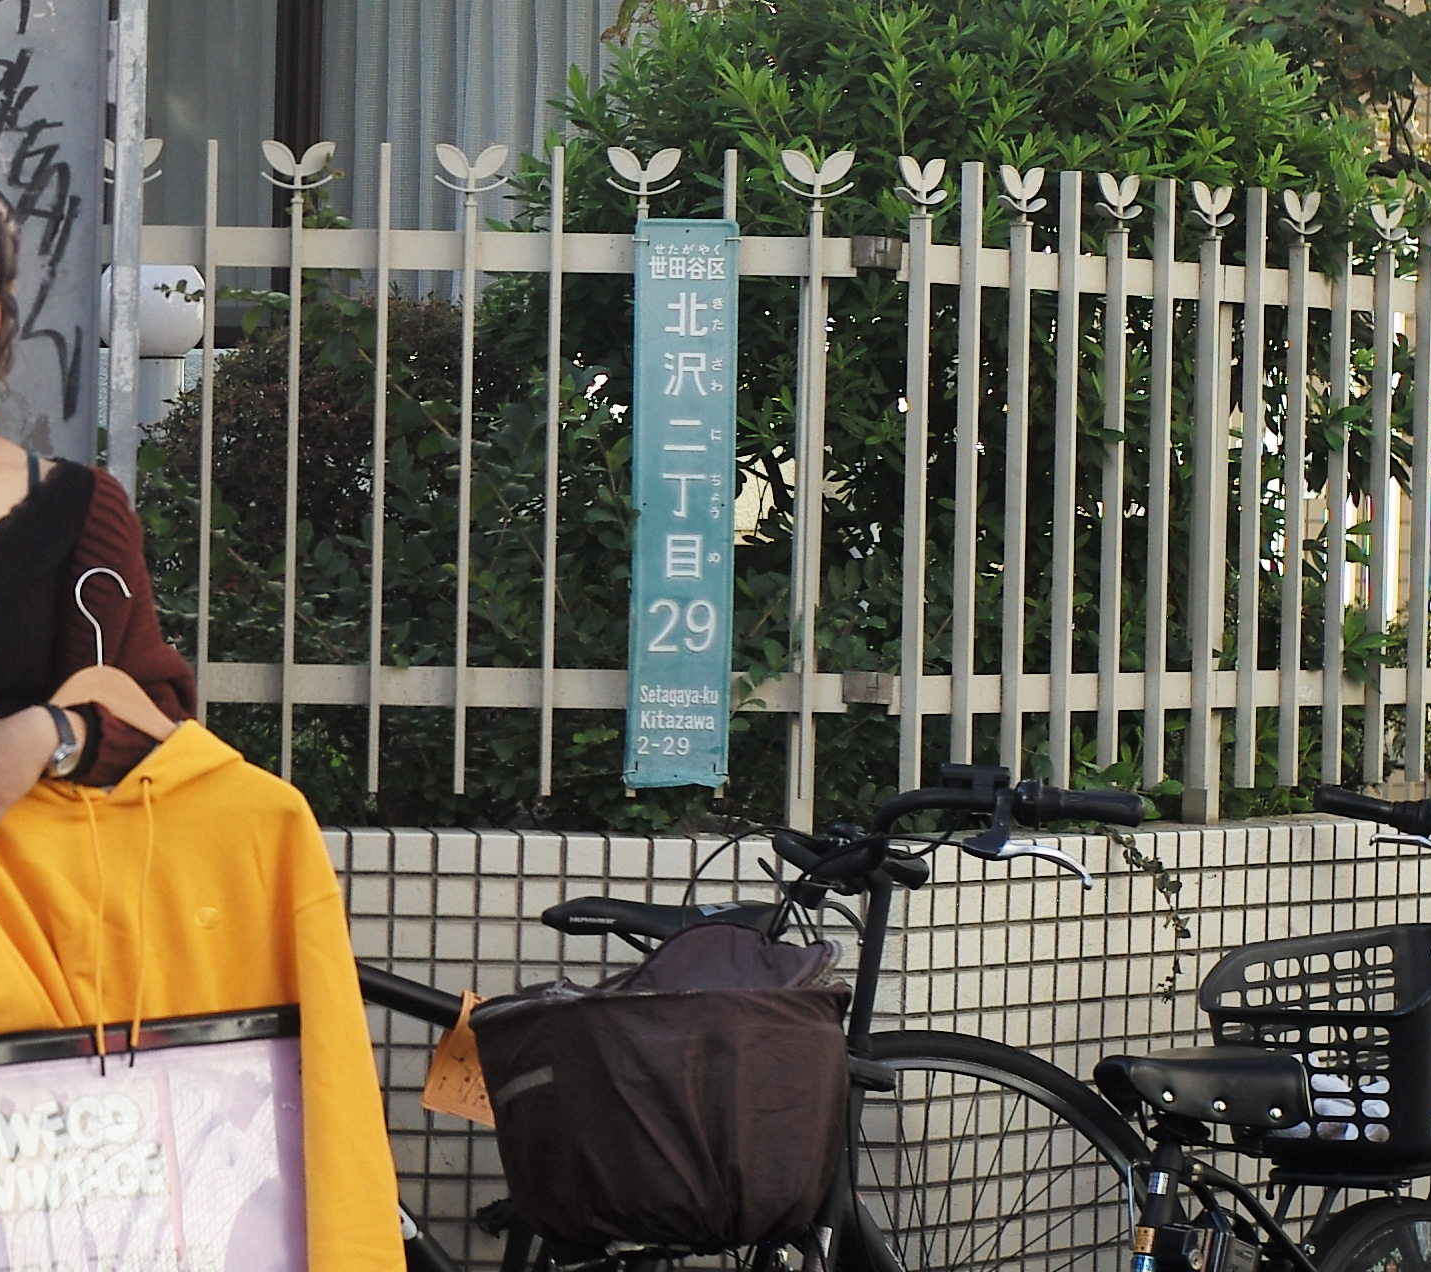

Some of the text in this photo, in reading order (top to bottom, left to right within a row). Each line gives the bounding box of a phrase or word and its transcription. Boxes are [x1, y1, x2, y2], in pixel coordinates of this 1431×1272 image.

[654, 244, 722, 256] せたがやく
[649, 255, 726, 280] 世田谷区
[660, 291, 709, 581] 北沢二丁目
[648, 598, 717, 653] 29
[639, 684, 719, 708] Setagaya-ku
[639, 710, 716, 731] Kitazawa
[637, 735, 690, 756] 2-29
